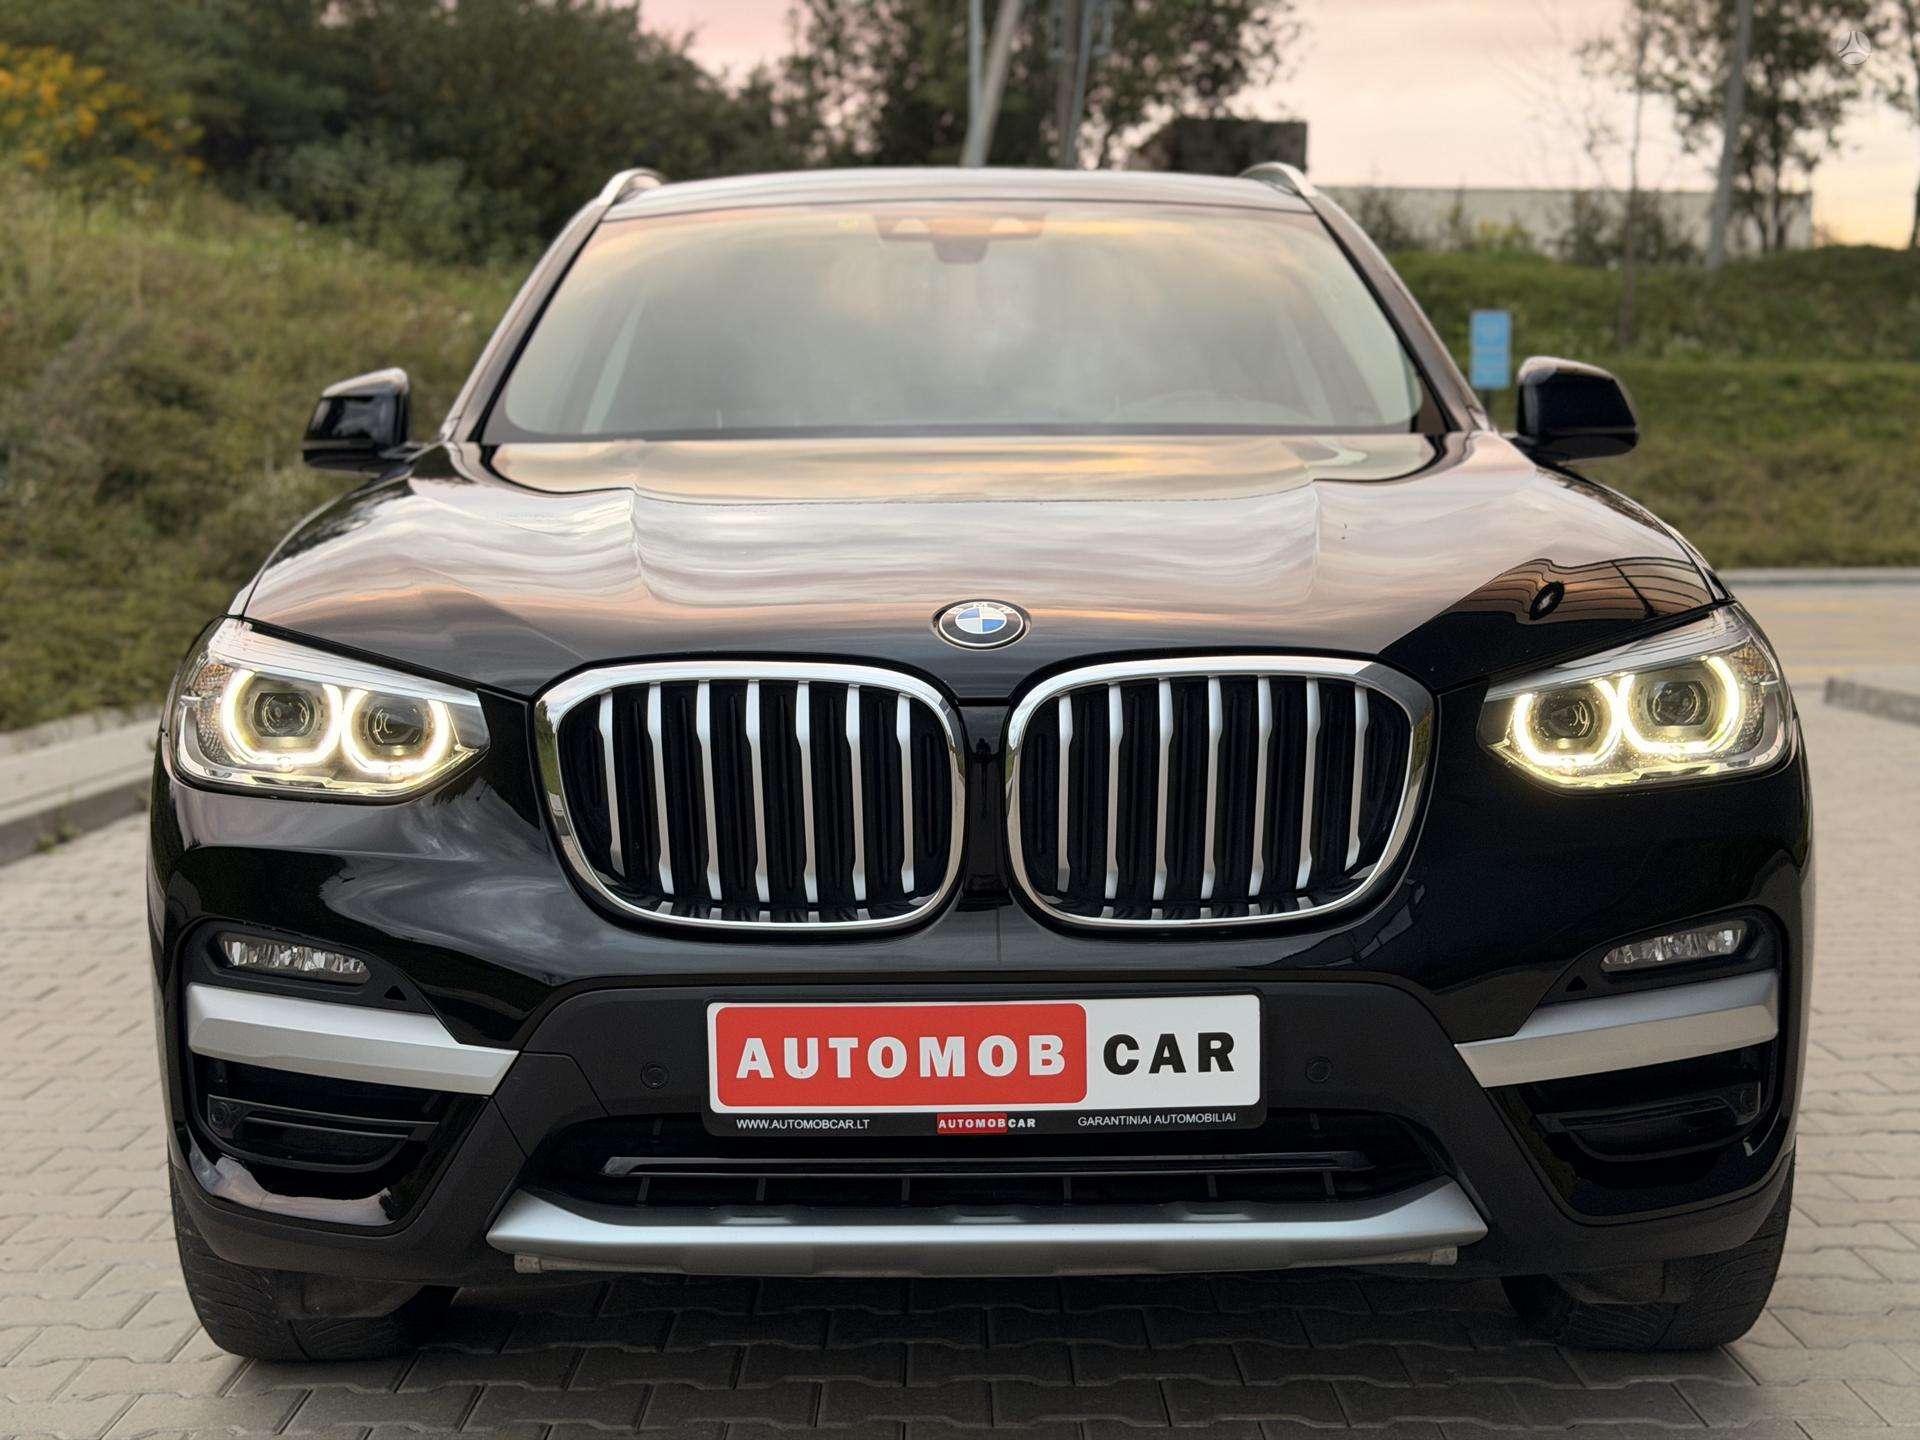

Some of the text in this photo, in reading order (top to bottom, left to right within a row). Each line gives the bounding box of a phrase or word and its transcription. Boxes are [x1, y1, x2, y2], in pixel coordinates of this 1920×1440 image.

[736, 1032, 1235, 1079] AUTOMOB CAR
[736, 1118, 870, 1129] WWW.AUTOMOBCAR.LT
[1077, 1112, 1237, 1127] GARANTINIAI AUTOMOBILIAI
